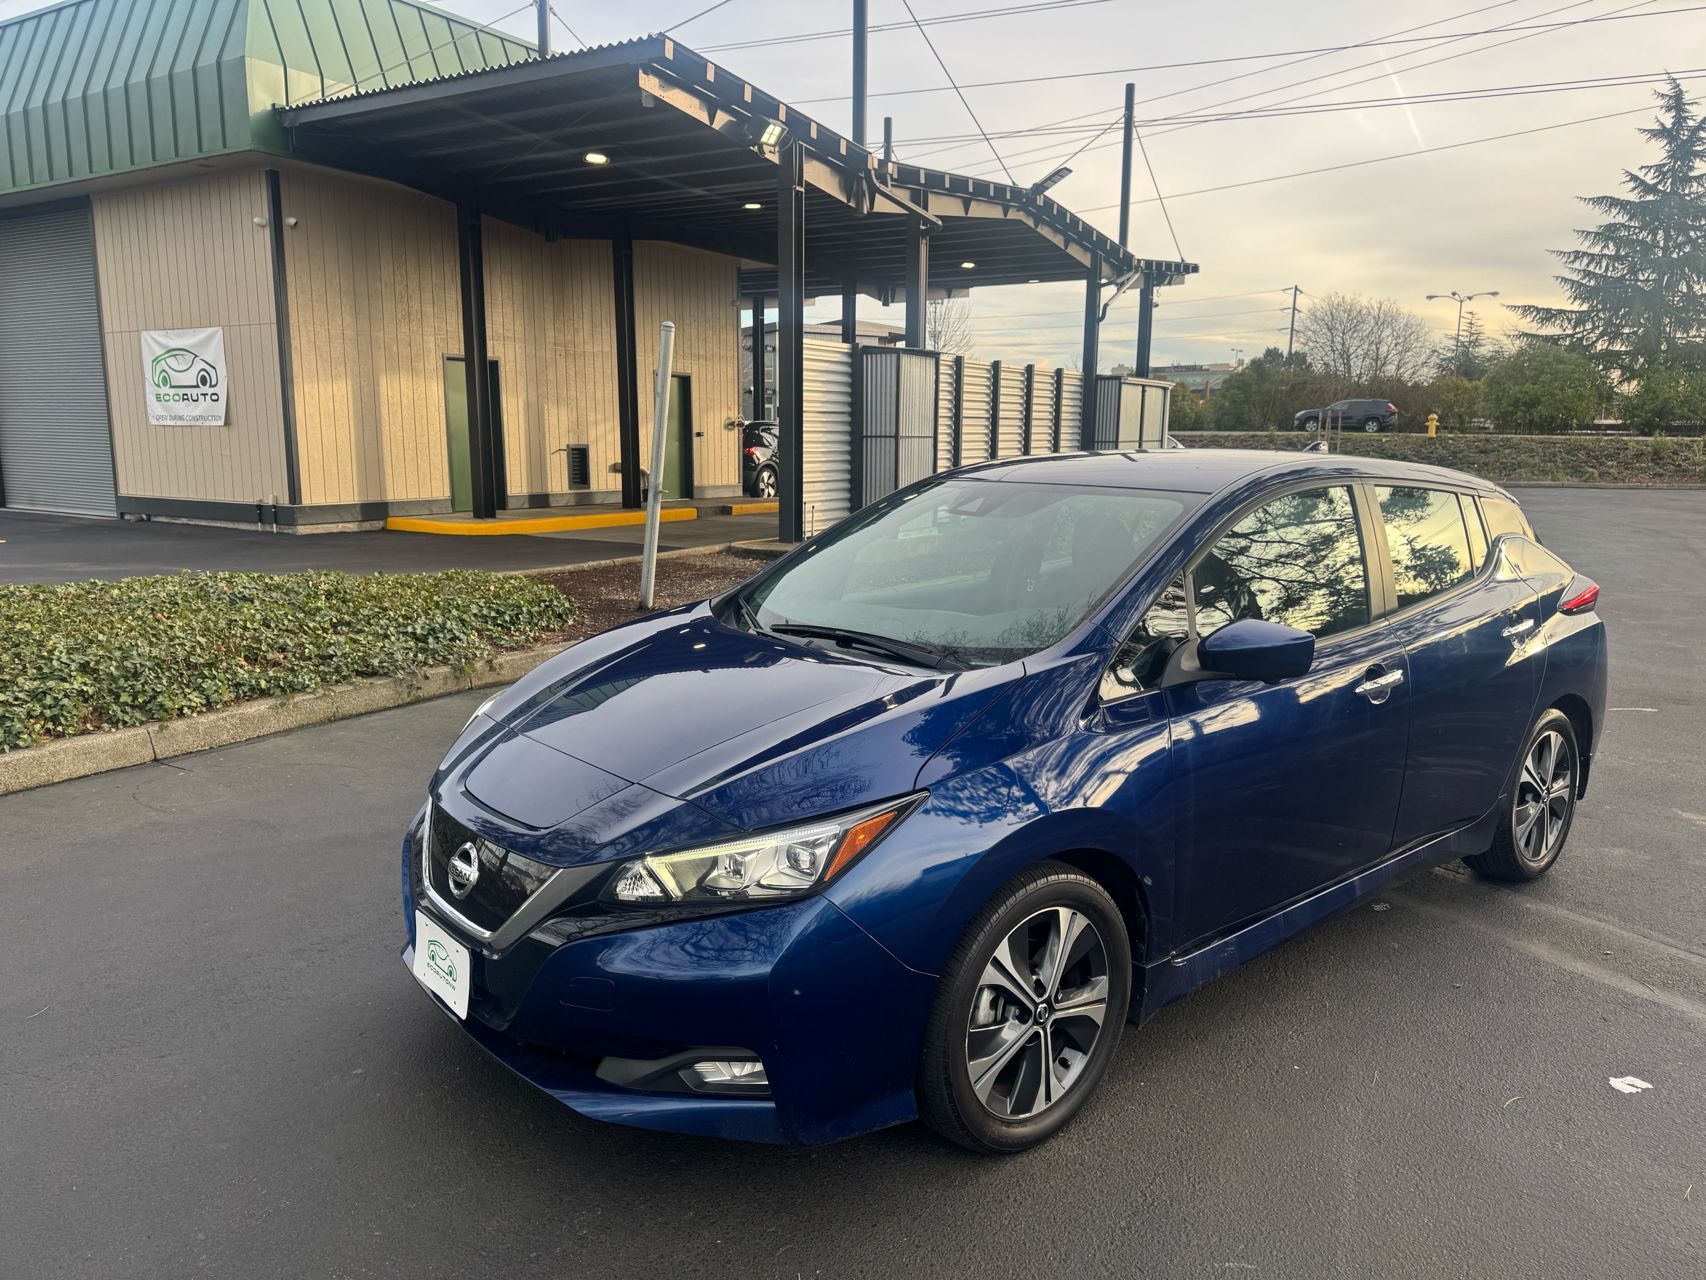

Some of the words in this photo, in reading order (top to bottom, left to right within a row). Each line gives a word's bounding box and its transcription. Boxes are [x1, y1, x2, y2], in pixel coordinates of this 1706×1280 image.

[155, 392, 220, 403] ECOAUTO
[156, 414, 168, 422] OPEN
[186, 414, 222, 422] CONSTRUCTION
